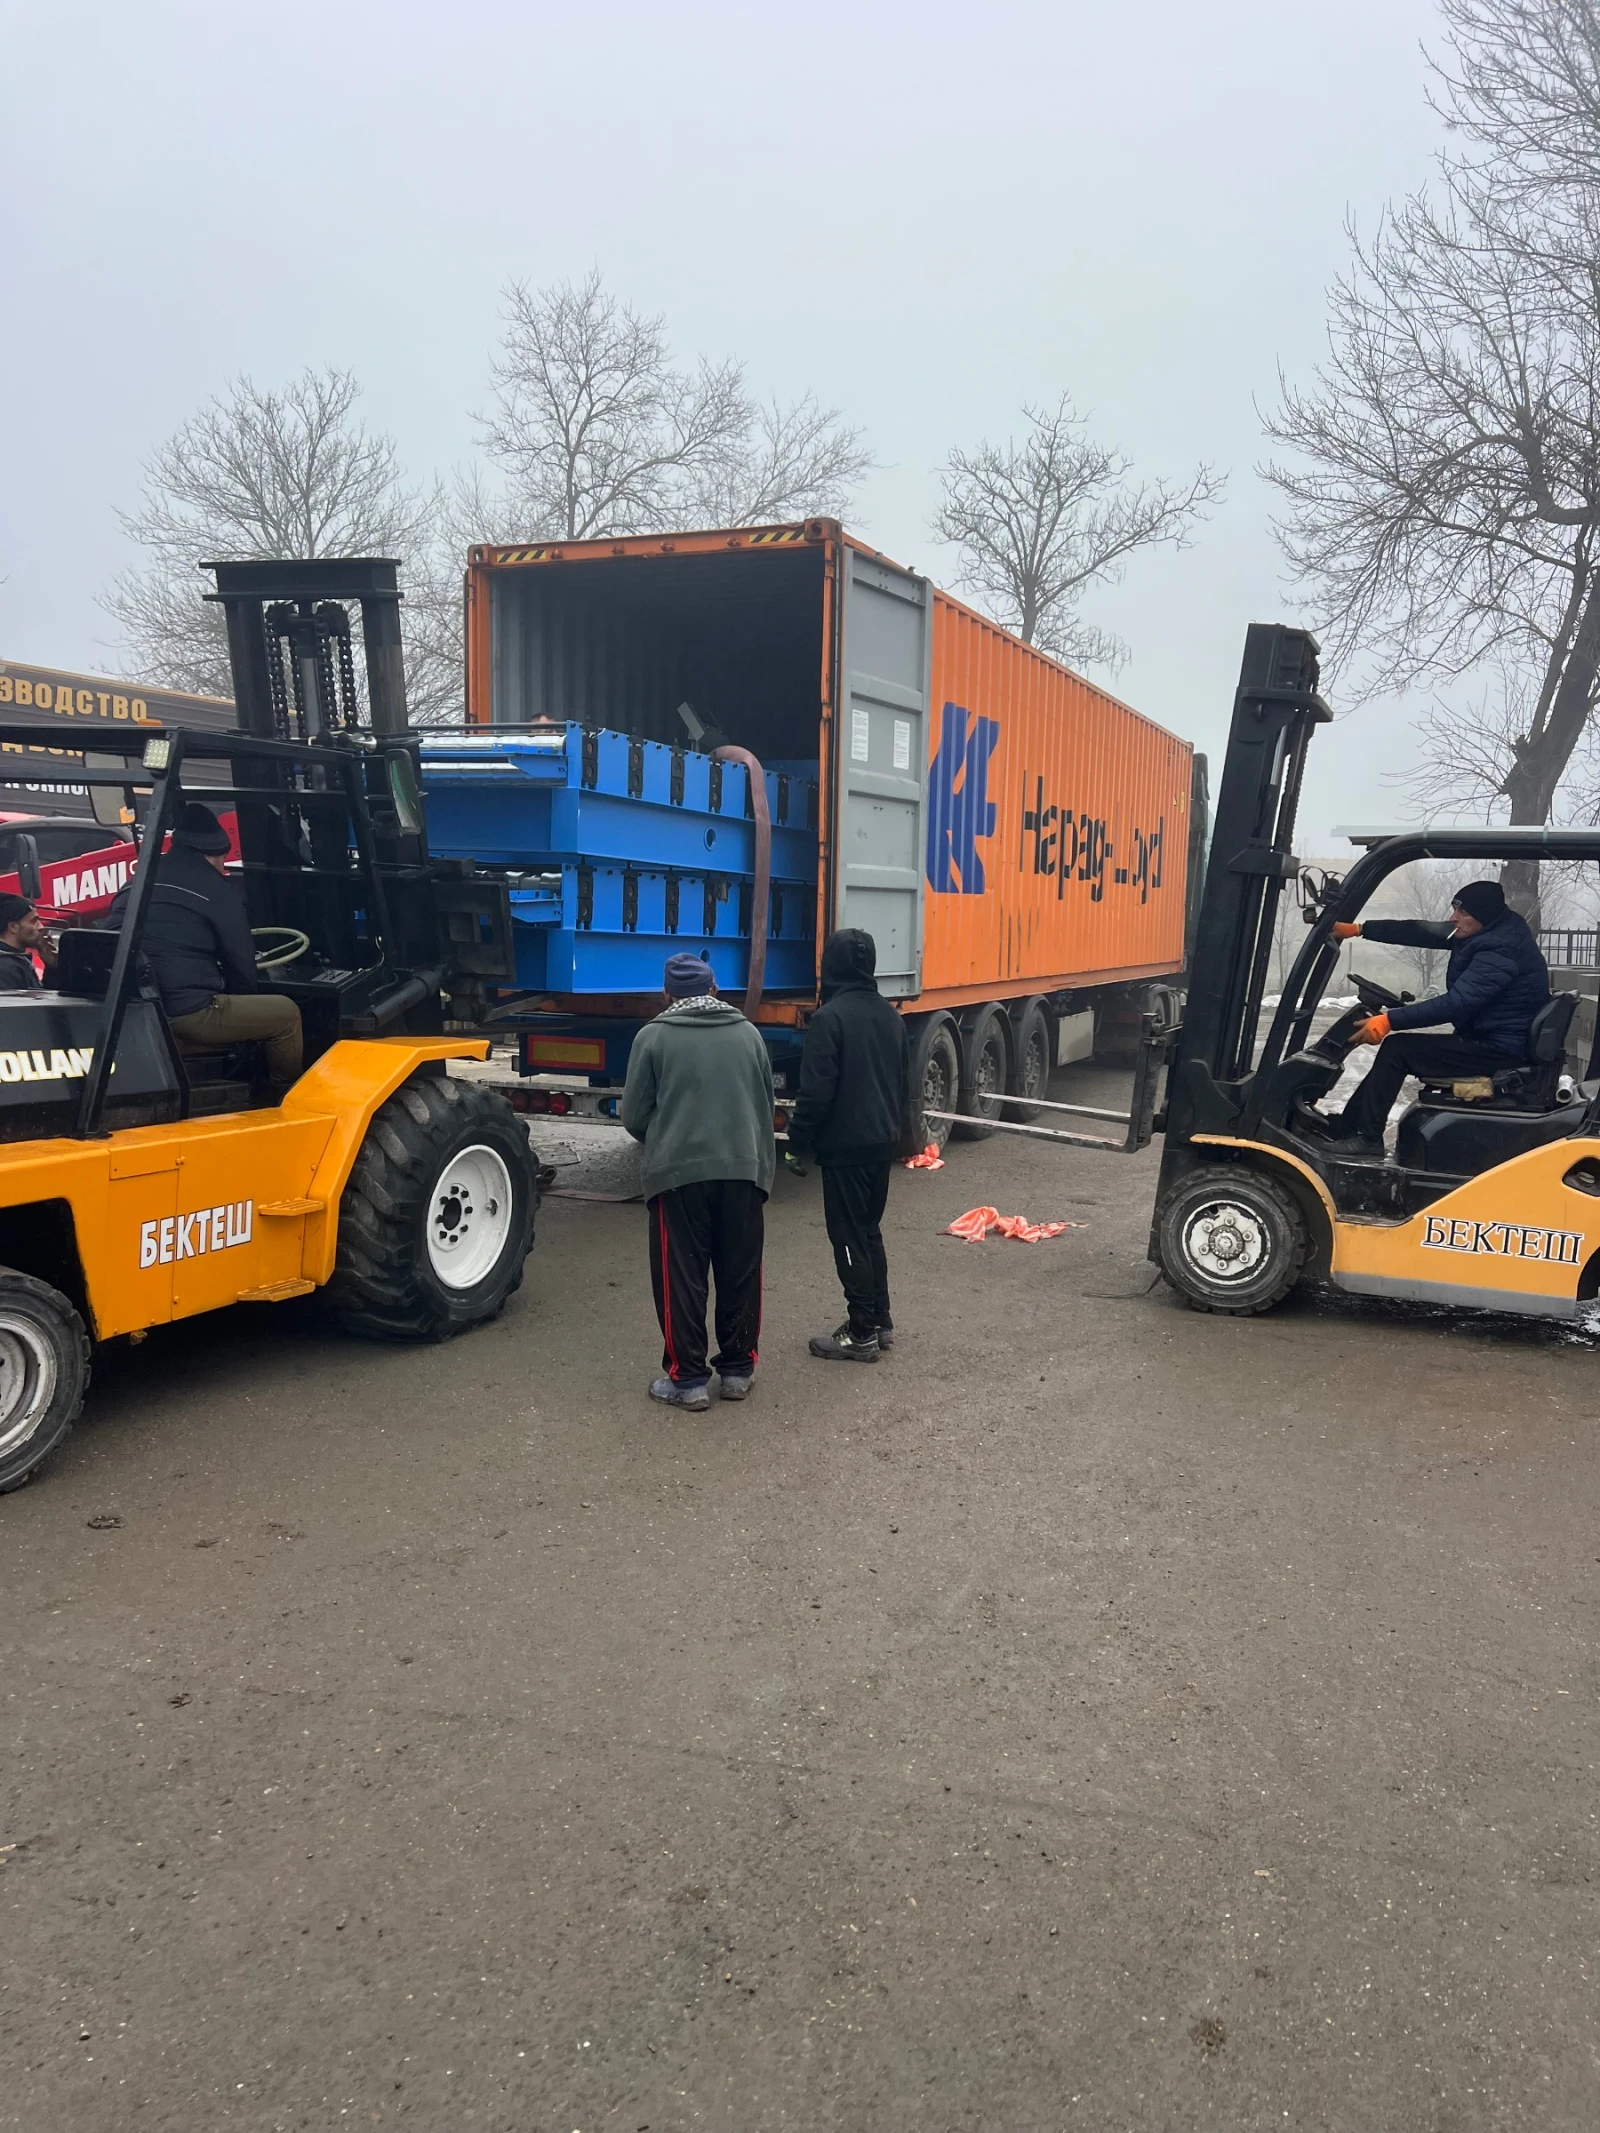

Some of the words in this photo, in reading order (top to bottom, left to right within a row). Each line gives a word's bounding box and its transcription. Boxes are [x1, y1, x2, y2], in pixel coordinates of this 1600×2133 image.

[1019, 770, 1164, 905] Hapag-Loyd
[0, 1048, 116, 1083] OLLAN
[139, 1199, 253, 1269] БЕКТЕШ
[1420, 1215, 1585, 1265] БЕКТЕШ
